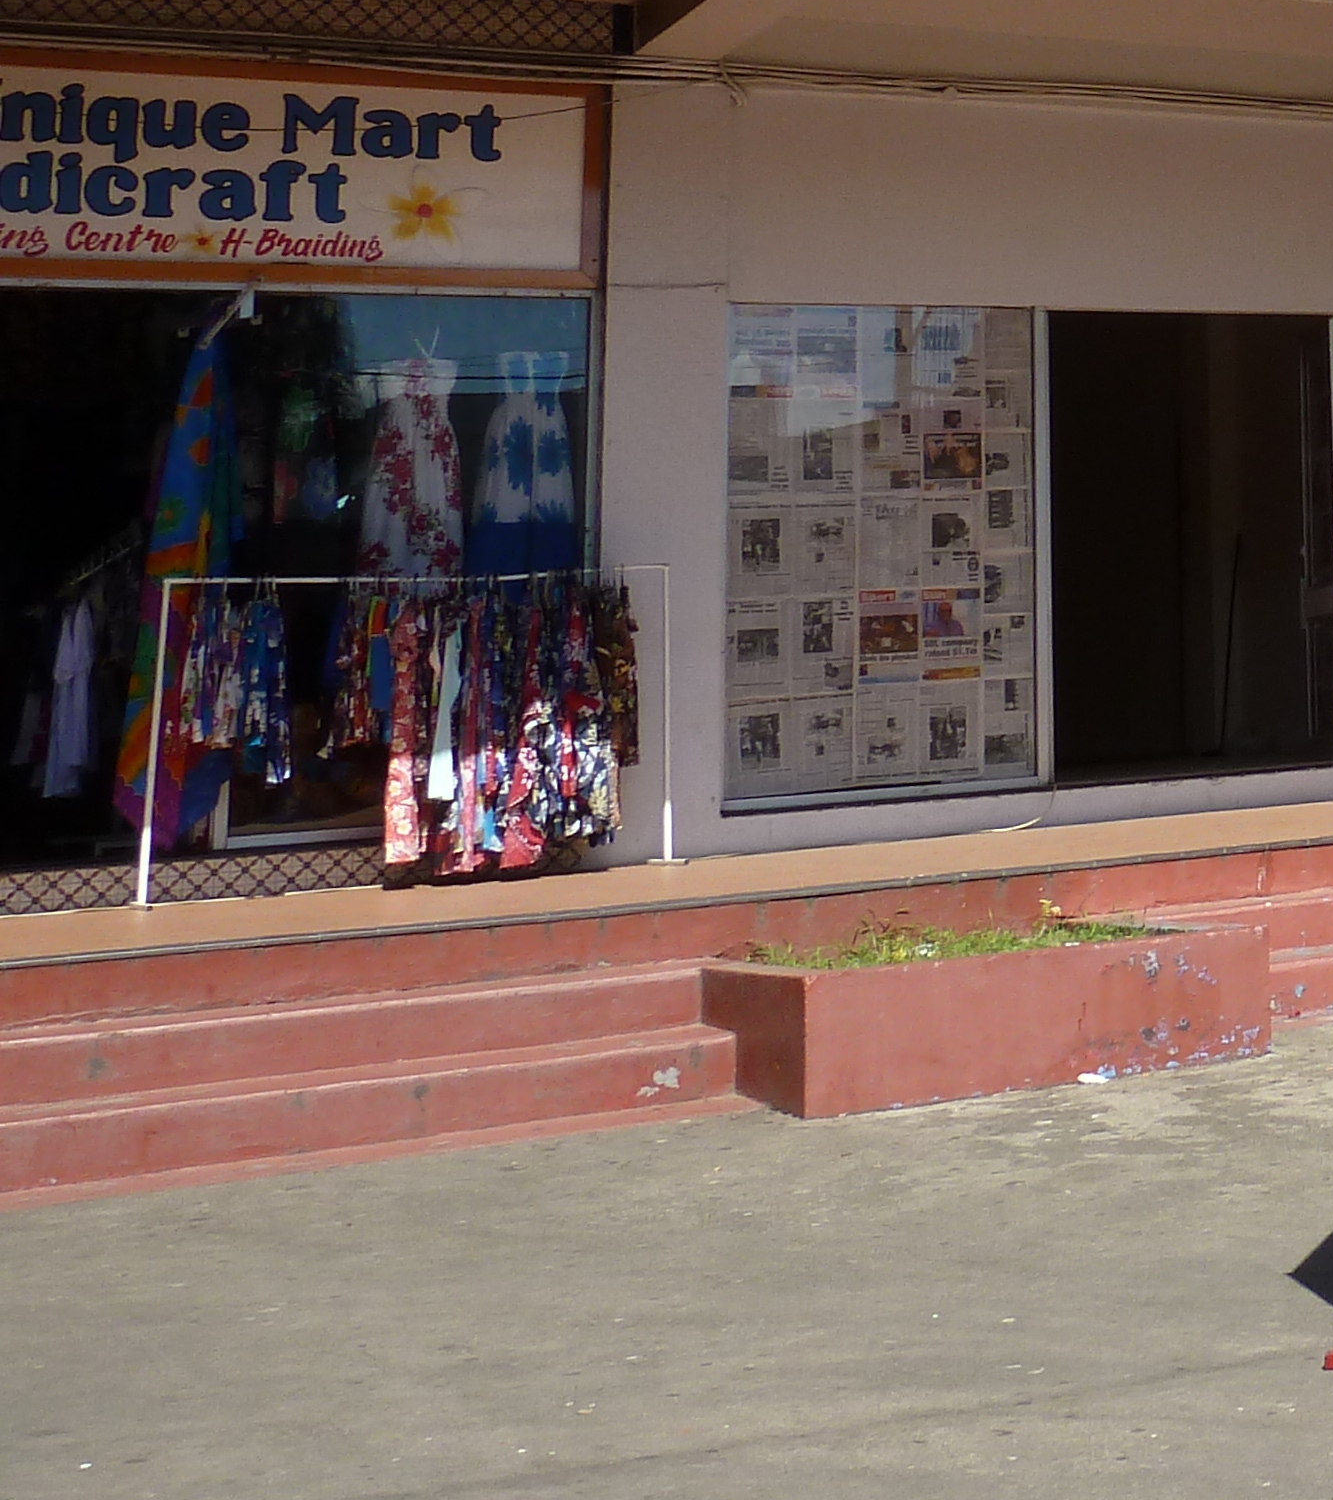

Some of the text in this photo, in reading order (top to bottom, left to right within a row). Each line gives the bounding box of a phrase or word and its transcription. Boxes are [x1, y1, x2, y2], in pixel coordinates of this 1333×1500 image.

[0, 80, 503, 164] nique Mart
[0, 151, 348, 225] dicraft
[65, 221, 179, 253] Centre
[219, 227, 385, 263] H-Braiding
